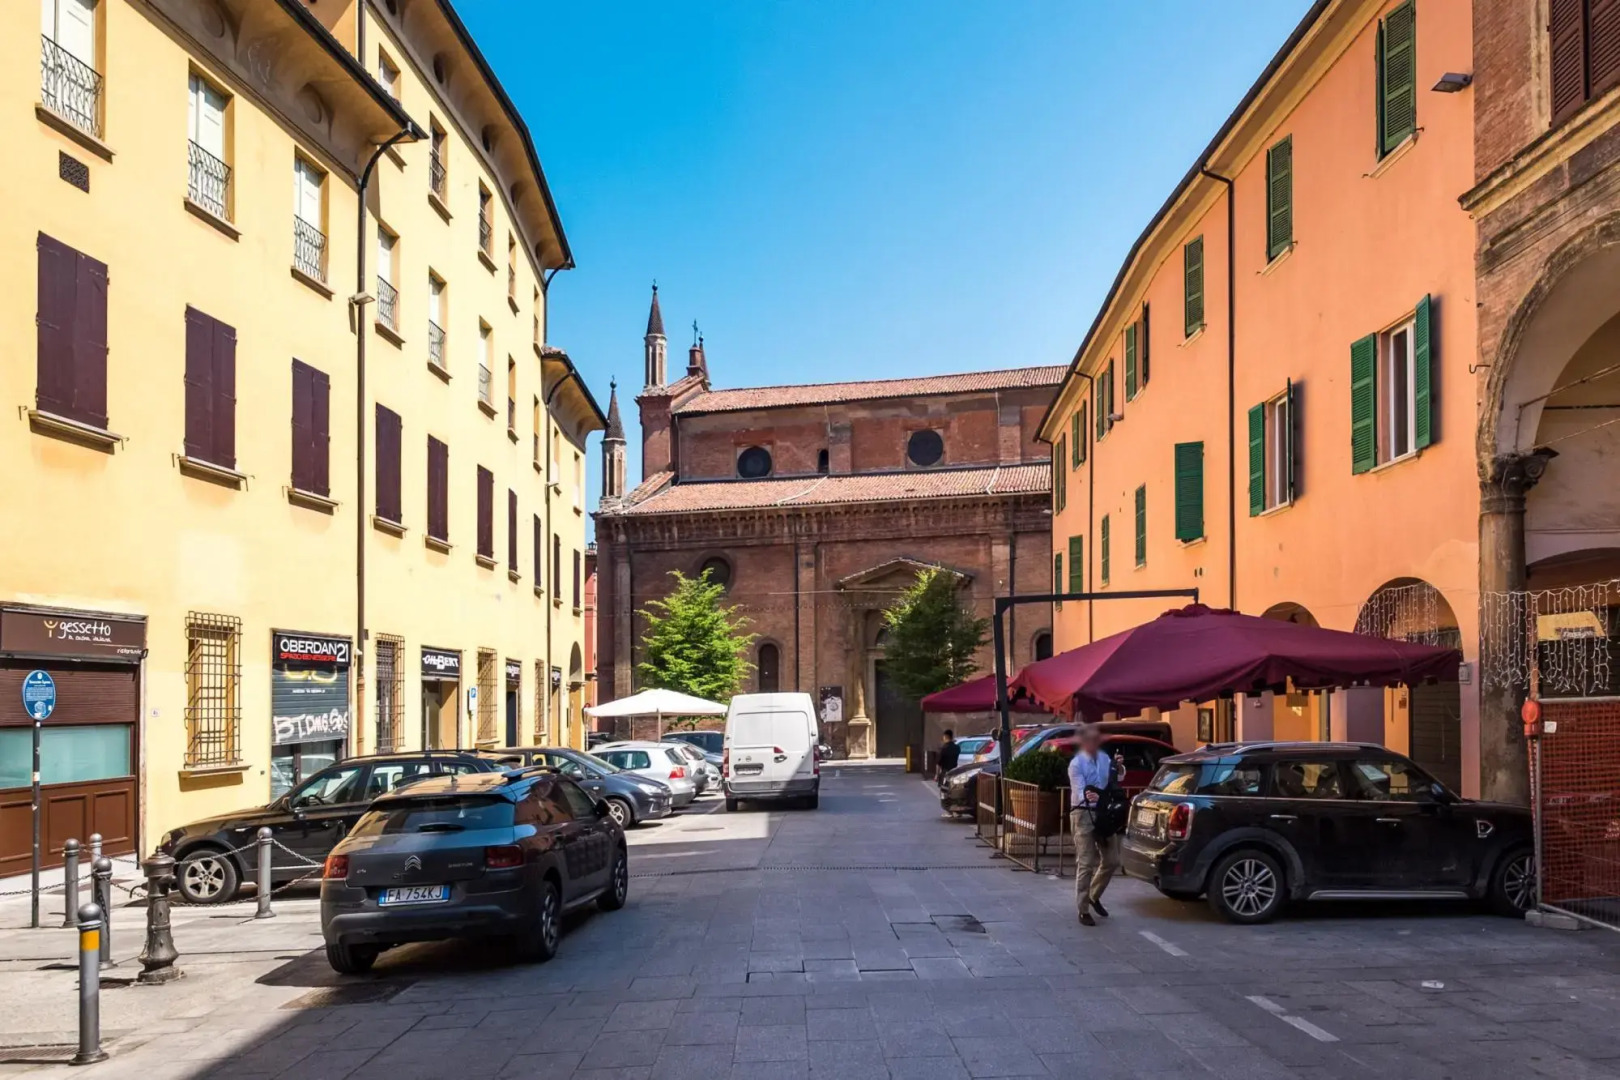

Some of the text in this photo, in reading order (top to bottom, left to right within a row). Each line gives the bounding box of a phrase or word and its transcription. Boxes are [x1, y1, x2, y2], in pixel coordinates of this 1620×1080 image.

[58, 621, 111, 639] gessetto
[280, 639, 349, 662] OBERDAN 21
